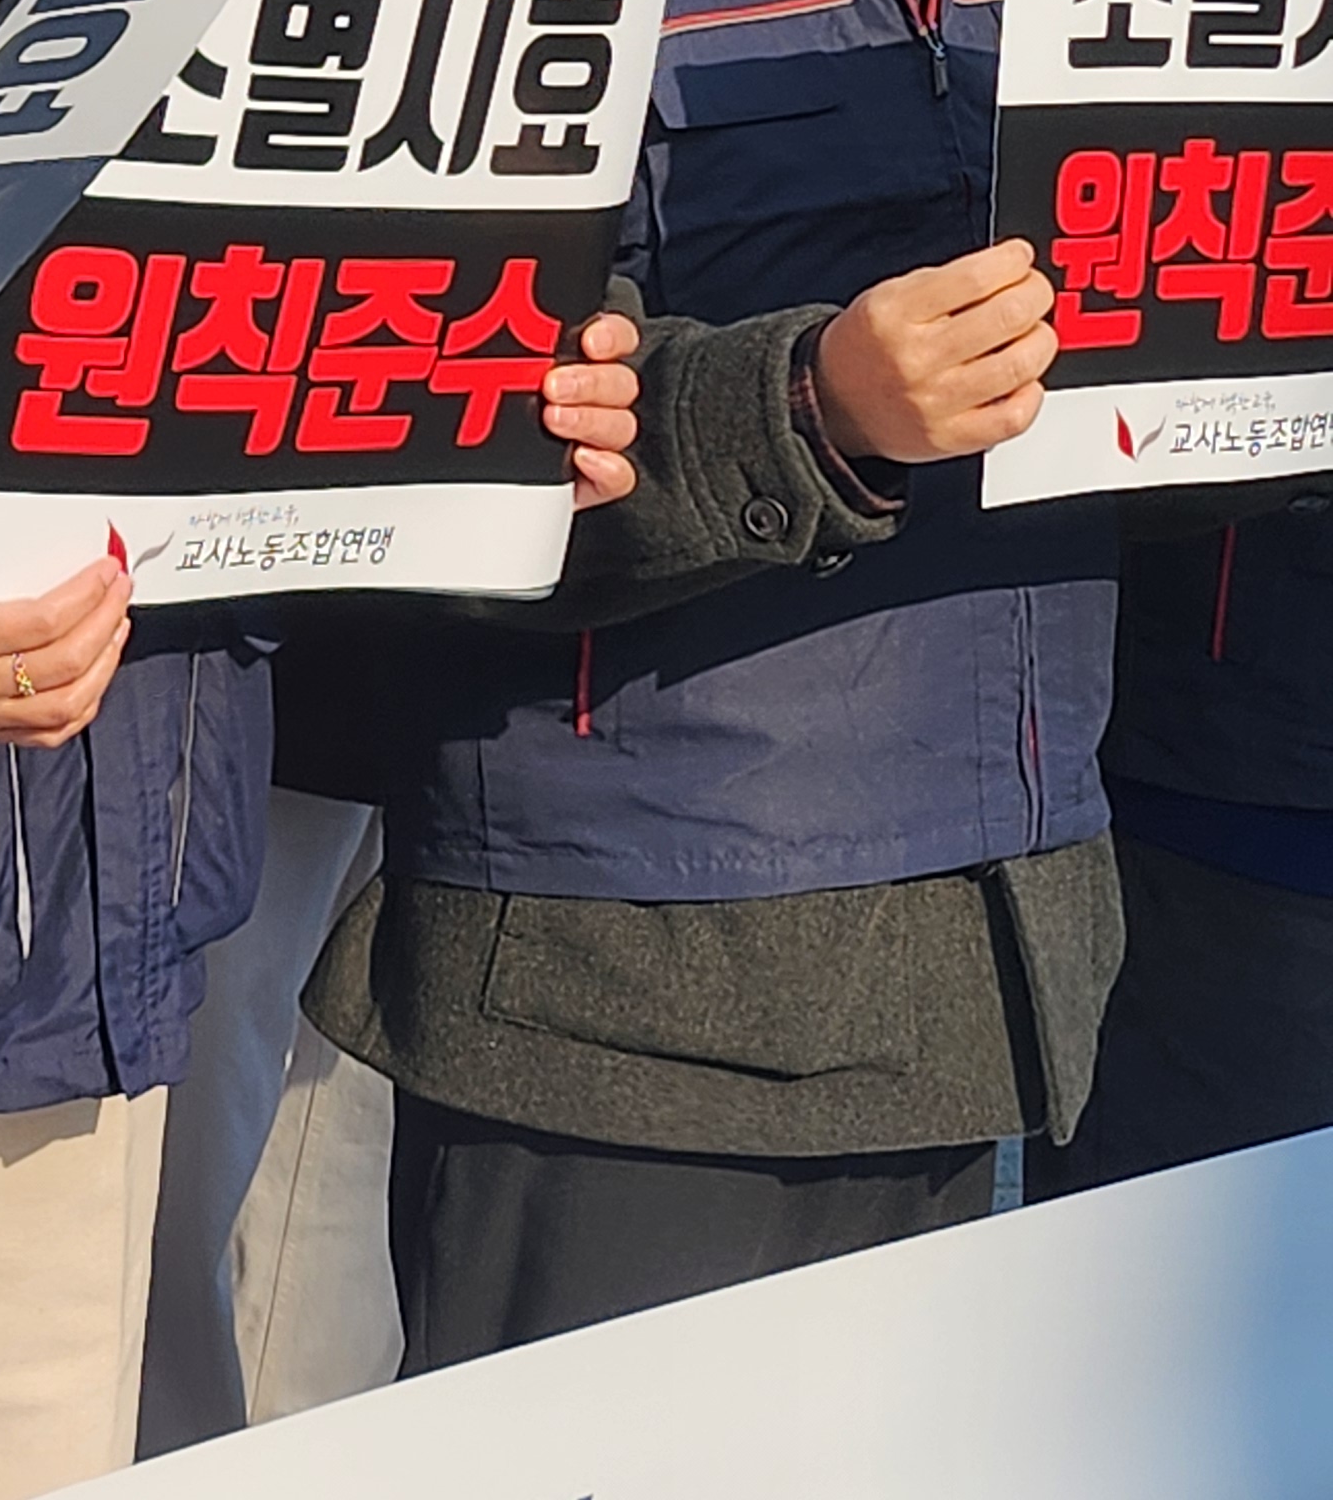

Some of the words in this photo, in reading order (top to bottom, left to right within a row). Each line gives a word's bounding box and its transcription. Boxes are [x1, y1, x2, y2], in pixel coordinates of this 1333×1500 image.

[11, 244, 561, 456] 원칙준수
[1169, 412, 1333, 458] 교사노동조합연
[175, 525, 396, 572] 교사노동조합연맹
